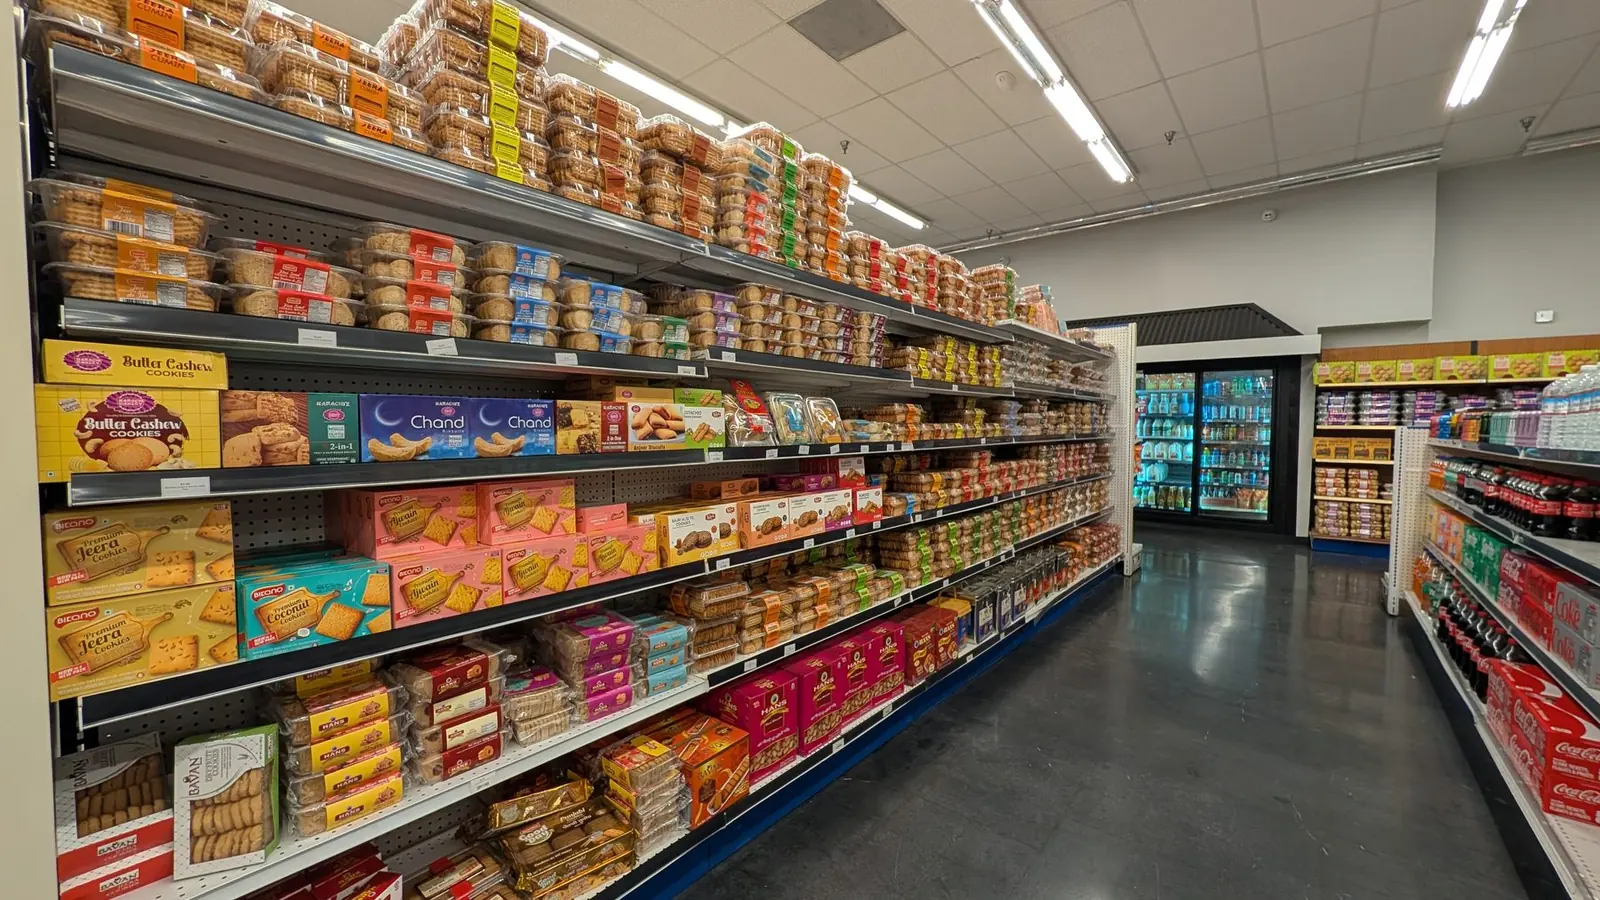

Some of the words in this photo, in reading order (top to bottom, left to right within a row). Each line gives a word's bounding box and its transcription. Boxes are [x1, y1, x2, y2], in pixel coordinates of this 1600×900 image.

[137, 3, 173, 20] CUMIN
[320, 34, 345, 48] JEERA
[151, 54, 186, 70] CUMIN
[357, 79, 383, 92] JEERA
[361, 123, 388, 136] JEERA
[122, 356, 162, 370] Butter
[166, 358, 214, 372] Cashew
[146, 370, 195, 378] COOKIES
[84, 417, 128, 430] Butter
[130, 417, 182, 430] Cashew
[411, 415, 464, 429] Chand
[508, 416, 552, 429] Chand
[109, 430, 161, 438] COOKIES
[390, 509, 418, 526] Ajwain
[82, 530, 123, 548] Premium
[76, 539, 120, 562] Jeera
[92, 546, 127, 563] Cookies
[410, 580, 440, 599] Ajwain
[267, 600, 310, 624] Coconut
[274, 599, 303, 613] Premium
[1556, 591, 1581, 632] Coke
[280, 610, 306, 625] Cookies
[84, 619, 127, 640] Premium
[78, 629, 122, 656] Jeera
[94, 636, 131, 655] Cookies
[879, 641, 897, 654] HANS
[847, 656, 866, 669] HANS
[306, 669, 329, 679] HANS
[813, 677, 835, 692] HANS
[761, 699, 787, 715] HANS
[322, 718, 345, 730] HANS
[323, 748, 346, 759] HANS
[188, 757, 200, 796] BAVAN
[337, 777, 358, 788] HANS
[338, 808, 361, 819] HANS
[519, 824, 549, 841] Good
[527, 830, 549, 843] Day
[98, 837, 136, 855] BAVAN
[100, 872, 138, 891] BAVAN
